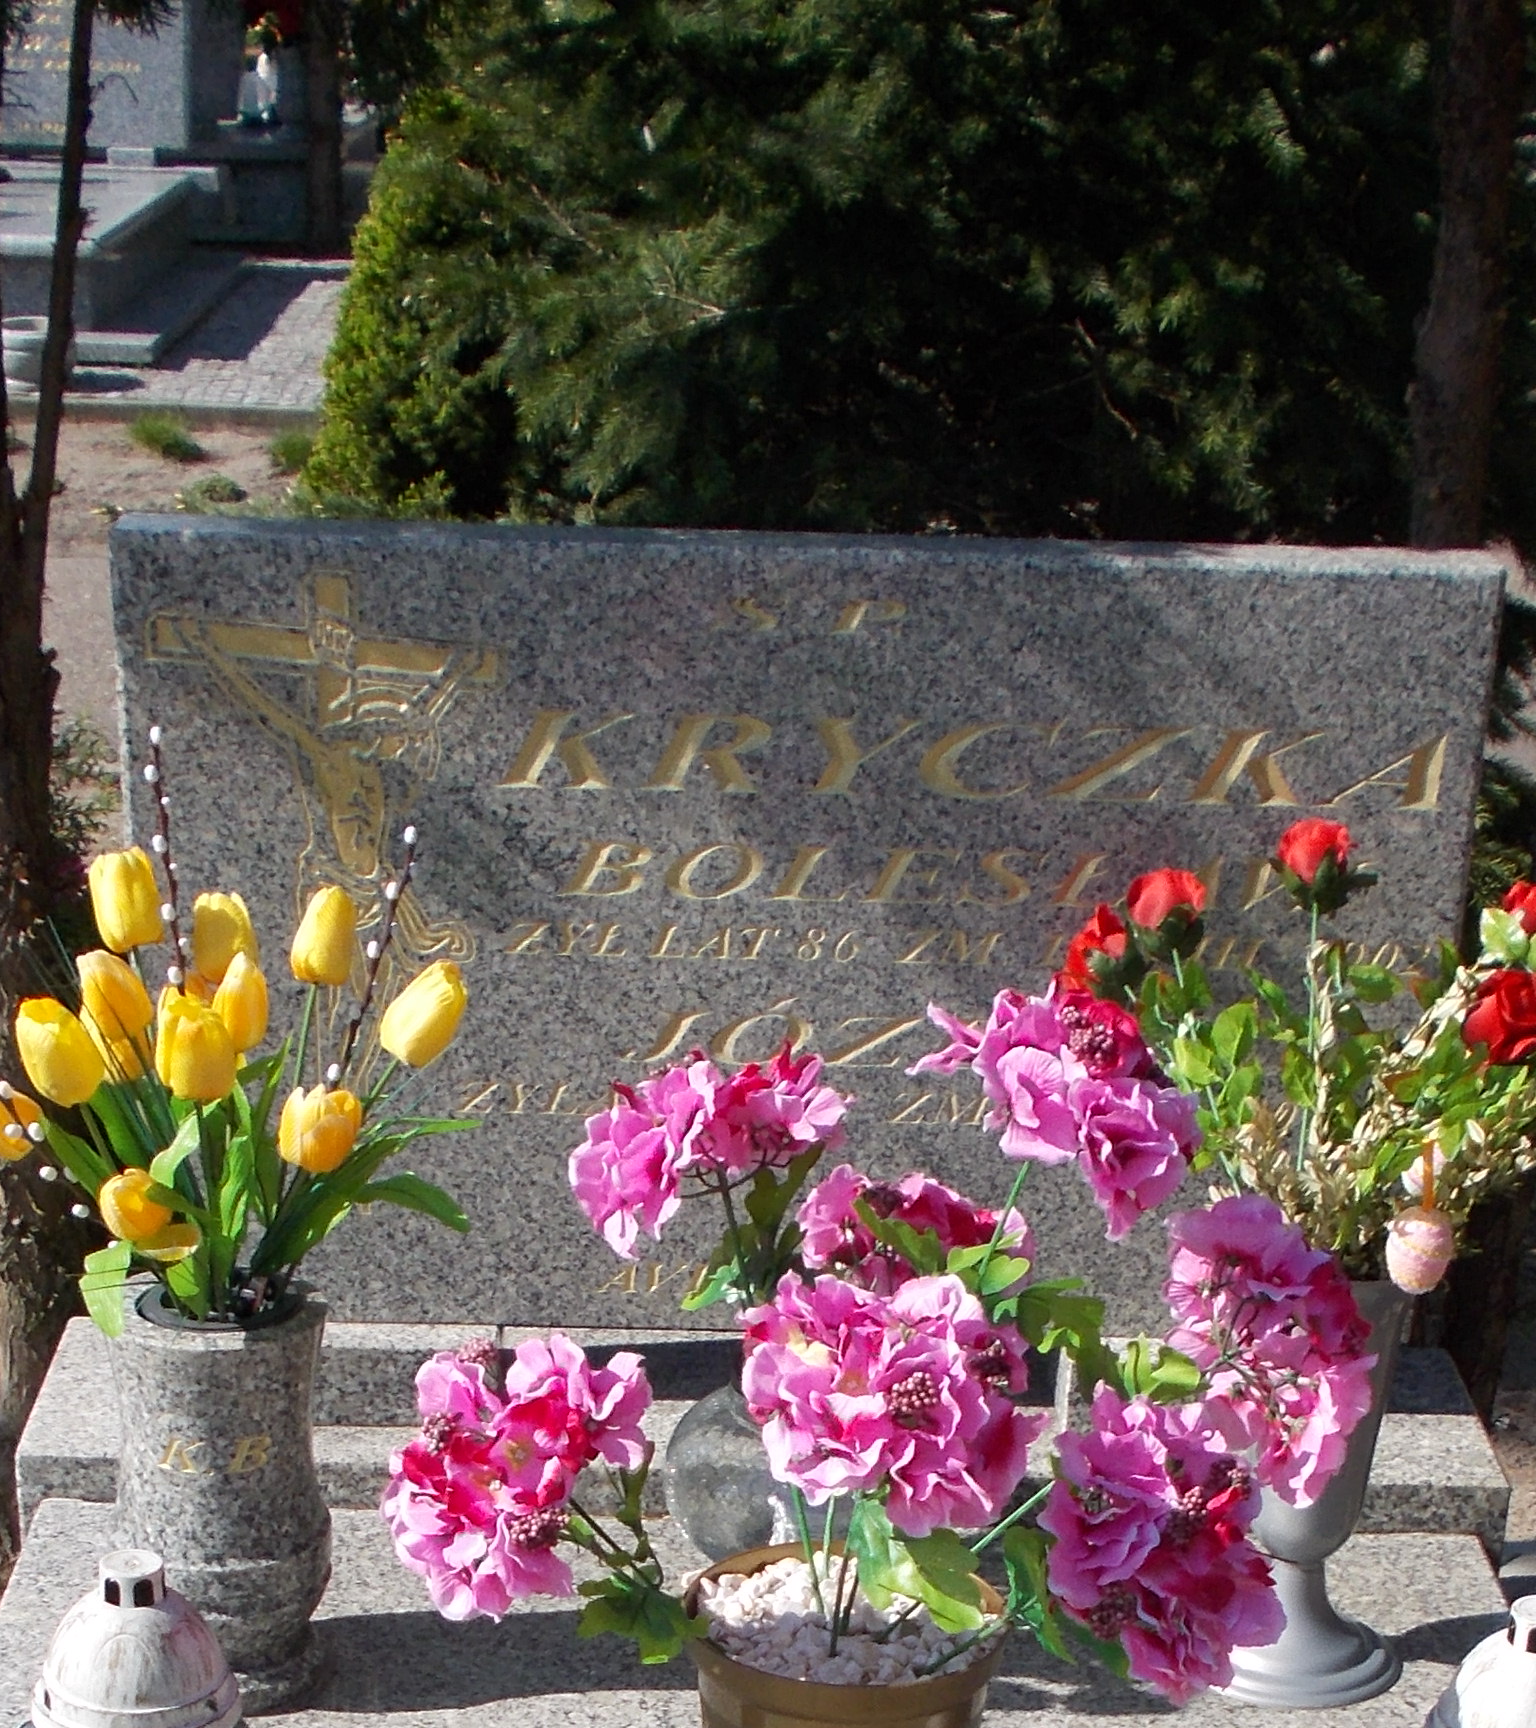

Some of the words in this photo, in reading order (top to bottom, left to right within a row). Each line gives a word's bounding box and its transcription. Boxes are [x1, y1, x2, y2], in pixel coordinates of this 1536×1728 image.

[492, 708, 1450, 810] KRYCZKA
[556, 838, 1378, 912] BOLESŁW
[648, 923, 780, 960] LAT
[797, 927, 864, 965] 86
[894, 929, 1004, 965] ZM
[224, 1434, 272, 1474] B
